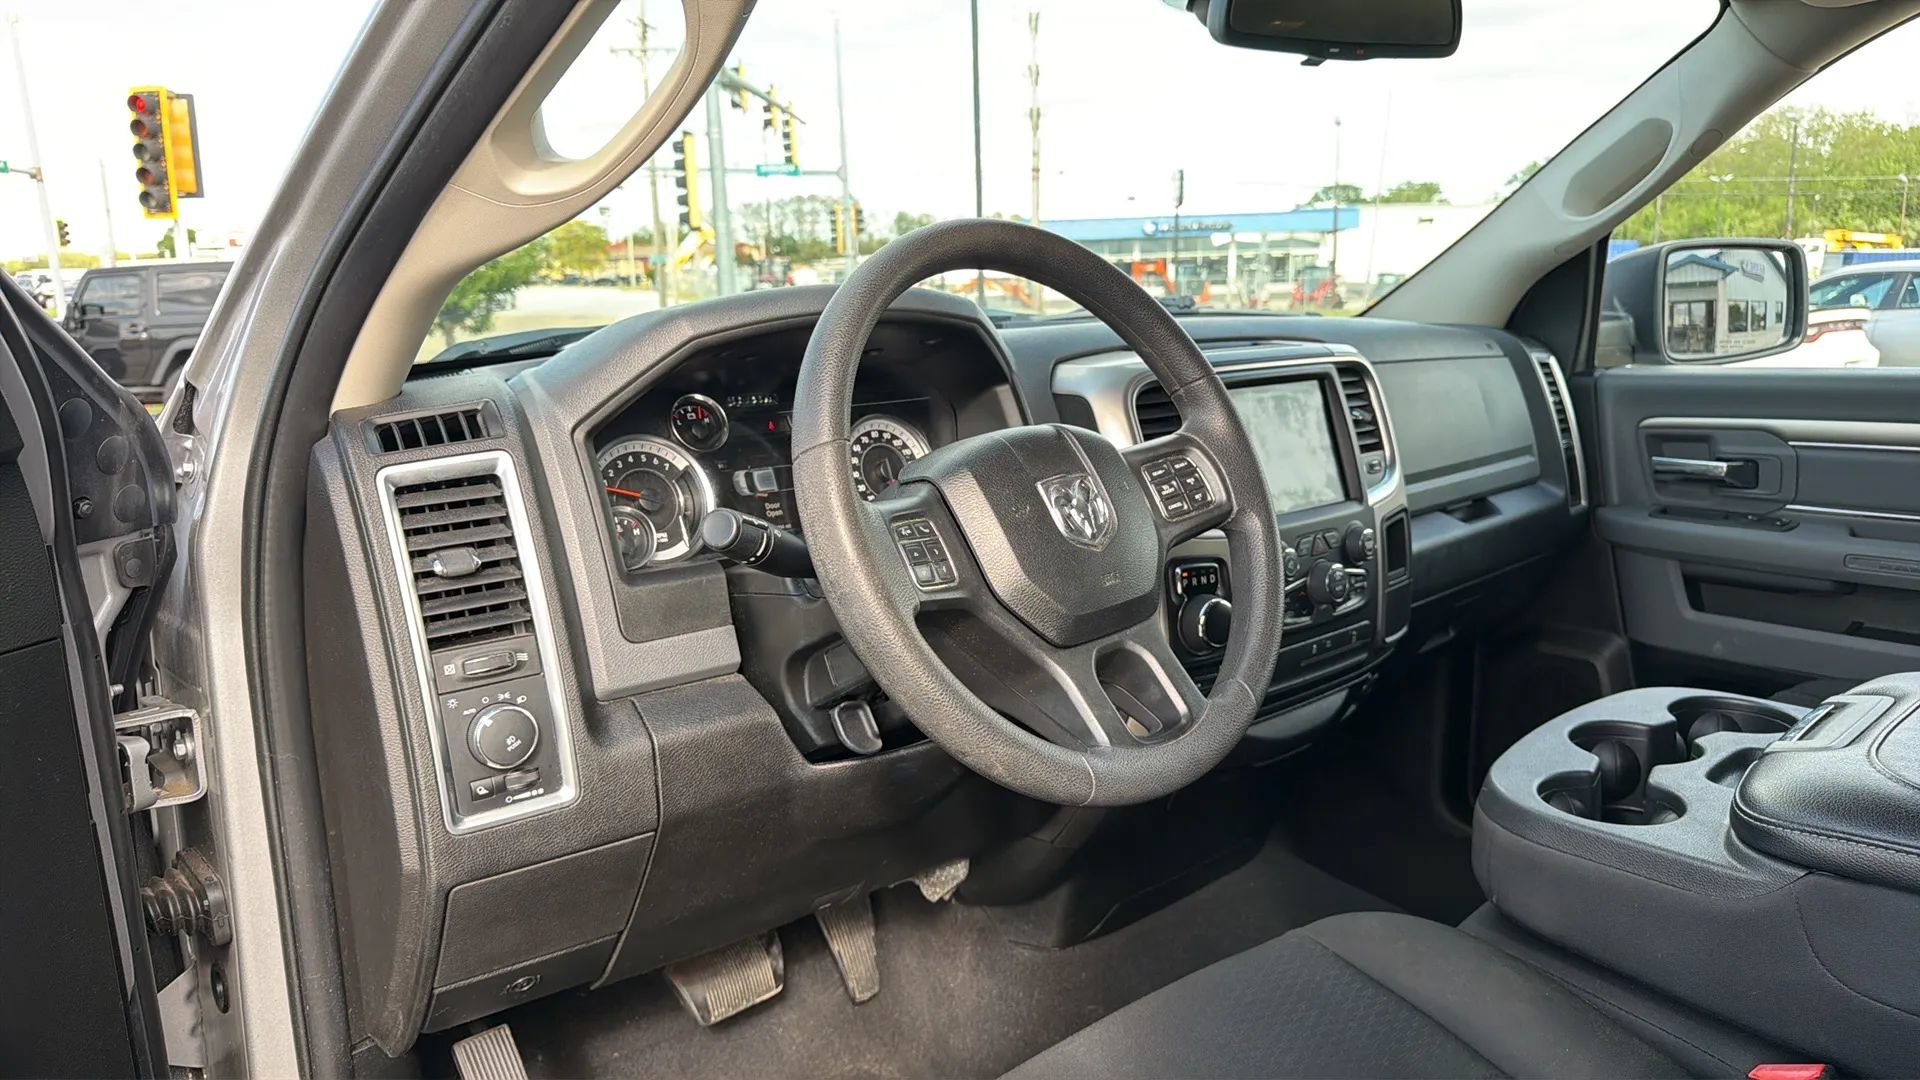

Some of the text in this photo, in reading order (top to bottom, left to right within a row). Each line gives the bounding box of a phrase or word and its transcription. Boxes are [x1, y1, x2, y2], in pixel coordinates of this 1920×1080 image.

[1192, 577, 1198, 586] R
[1200, 576, 1207, 584] N
[1210, 575, 1216, 583] D
